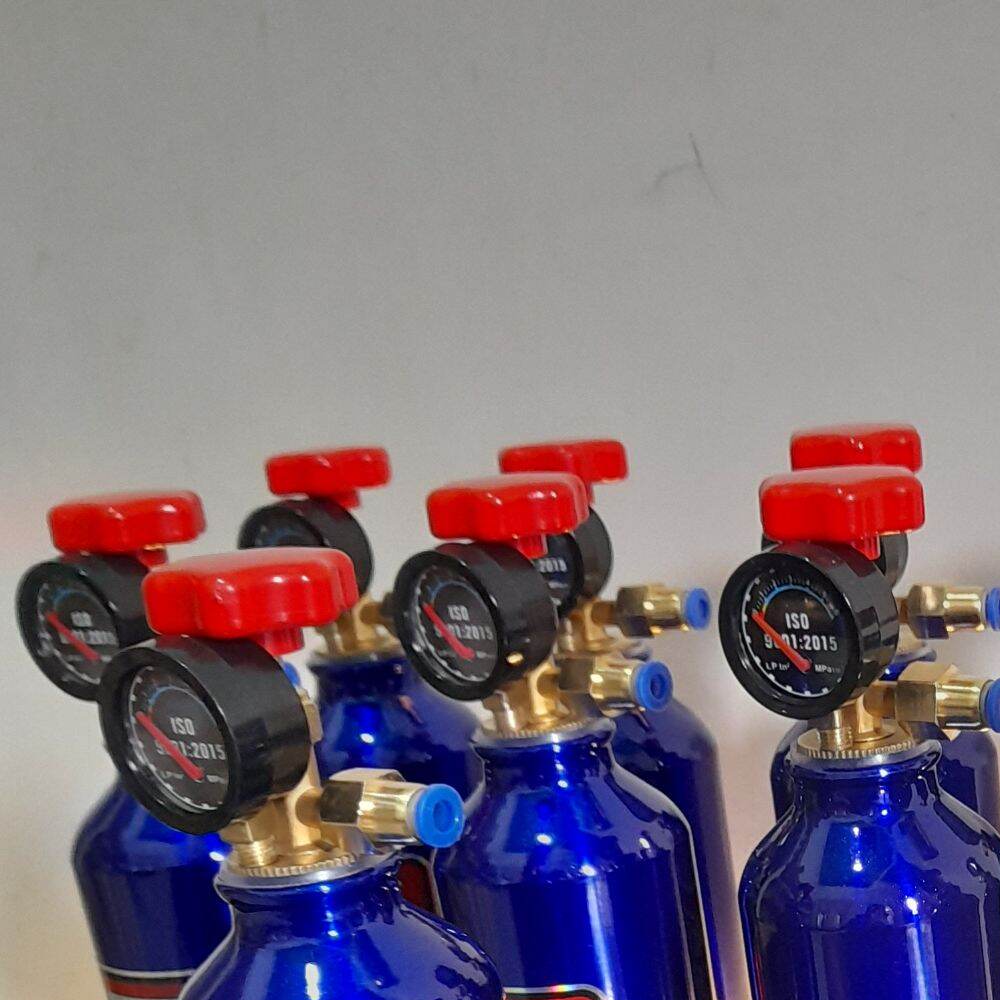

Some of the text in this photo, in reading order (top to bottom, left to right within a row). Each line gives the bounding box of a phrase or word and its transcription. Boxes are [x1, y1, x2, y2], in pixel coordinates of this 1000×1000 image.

[448, 605, 469, 621] ISO
[785, 612, 809, 630] ISO
[434, 624, 494, 640] 01:2015
[170, 717, 195, 736] ISO
[155, 740, 226, 760] 91:2015
